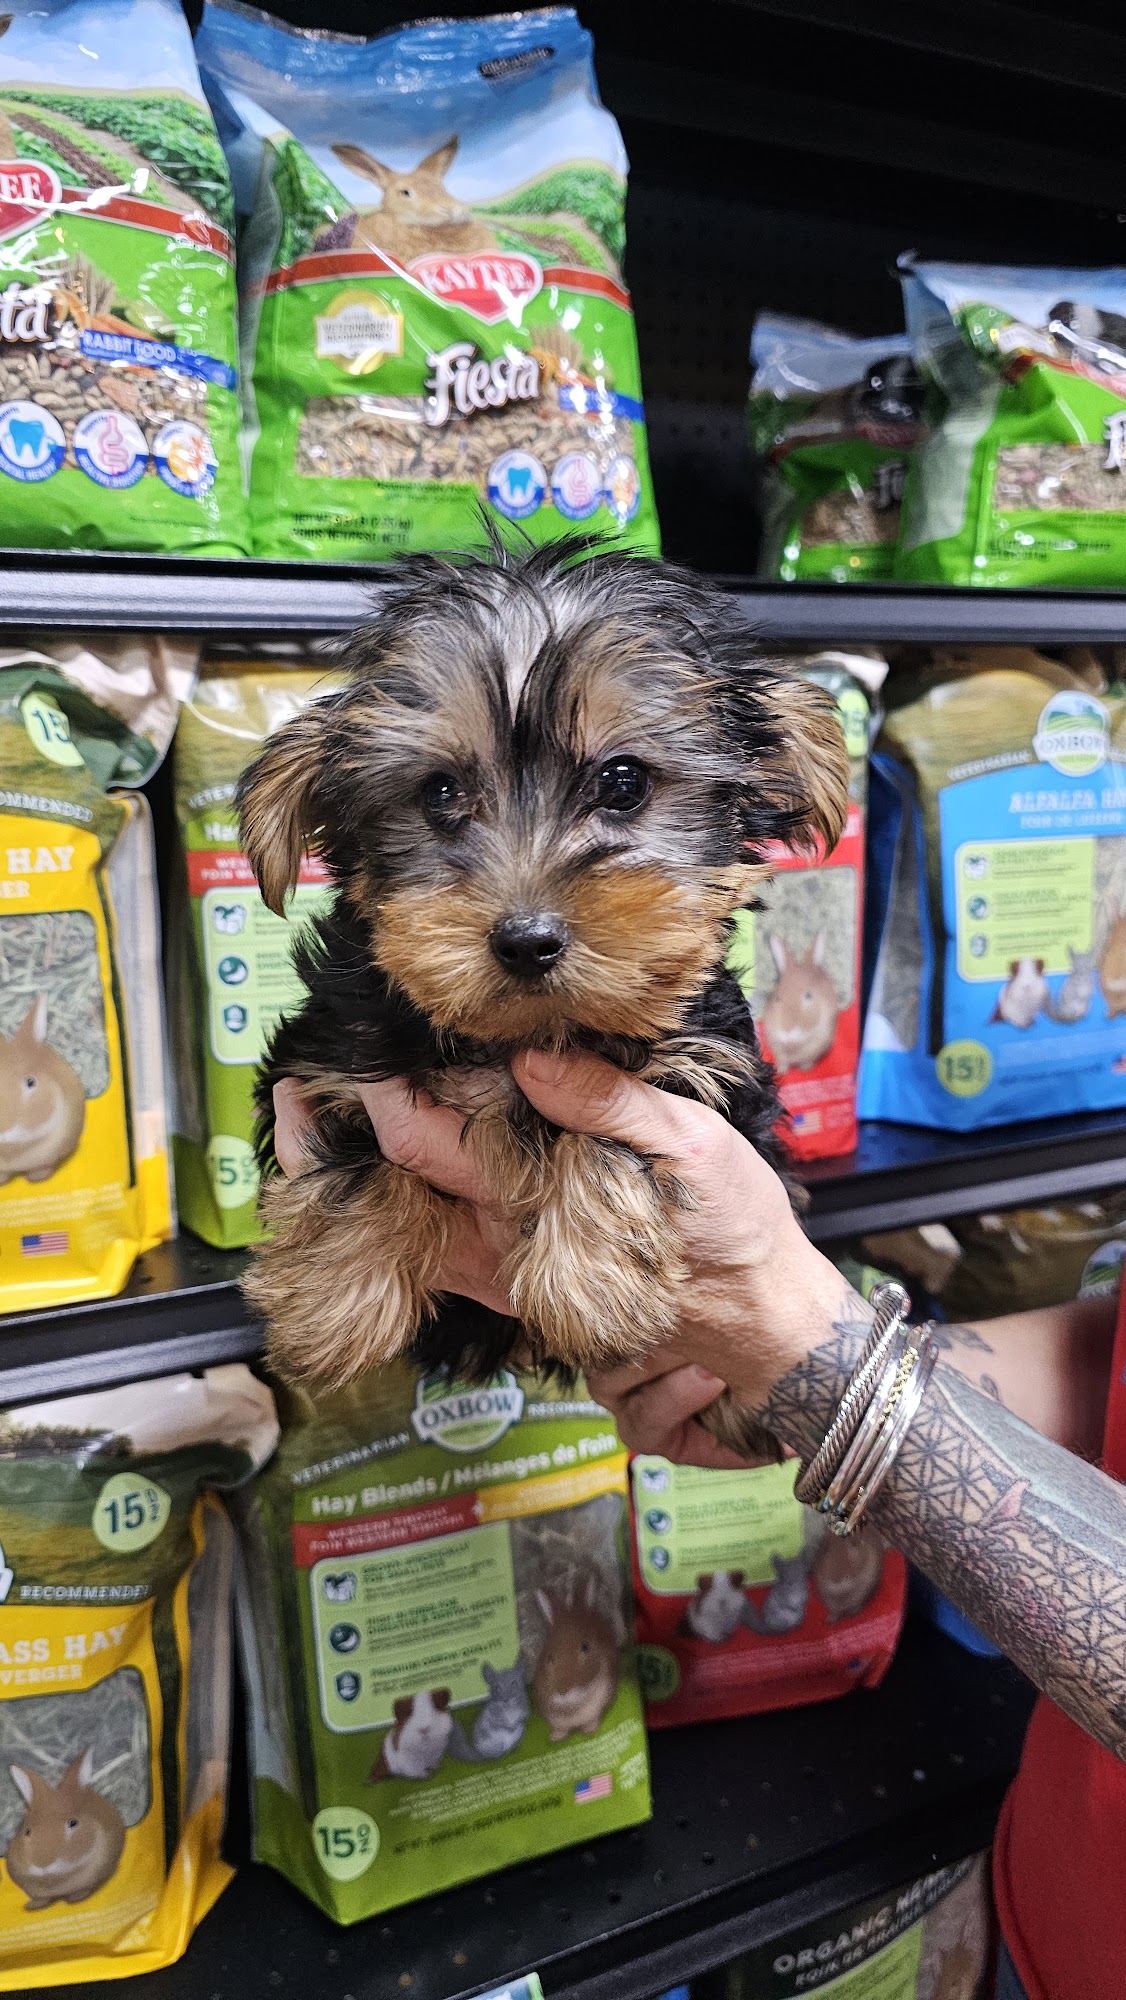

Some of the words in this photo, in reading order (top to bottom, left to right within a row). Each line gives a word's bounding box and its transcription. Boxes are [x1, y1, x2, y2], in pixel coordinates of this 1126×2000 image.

[419, 260, 536, 293] KAYTEE
[82, 330, 132, 353] RABBIT
[134, 341, 177, 362] FOOD
[424, 341, 540, 427] Fiesta
[1008, 788, 1097, 813] ALFALFA
[6, 845, 75, 874] HAY
[421, 1390, 515, 1428] OXBOW
[291, 1431, 411, 1485] VETERINARIAN
[311, 1493, 358, 1516] Hay
[361, 1476, 437, 1508] Blends
[453, 1451, 550, 1485] Mélanges
[552, 1443, 577, 1465] de
[578, 1433, 618, 1459] Foin
[104, 1491, 145, 1535] 15
[20, 1585, 150, 1600] RECOMMENDE
[63, 1623, 128, 1660] HAY
[319, 1826, 355, 1858] 15
[773, 1906, 894, 1975] ORGANIC
